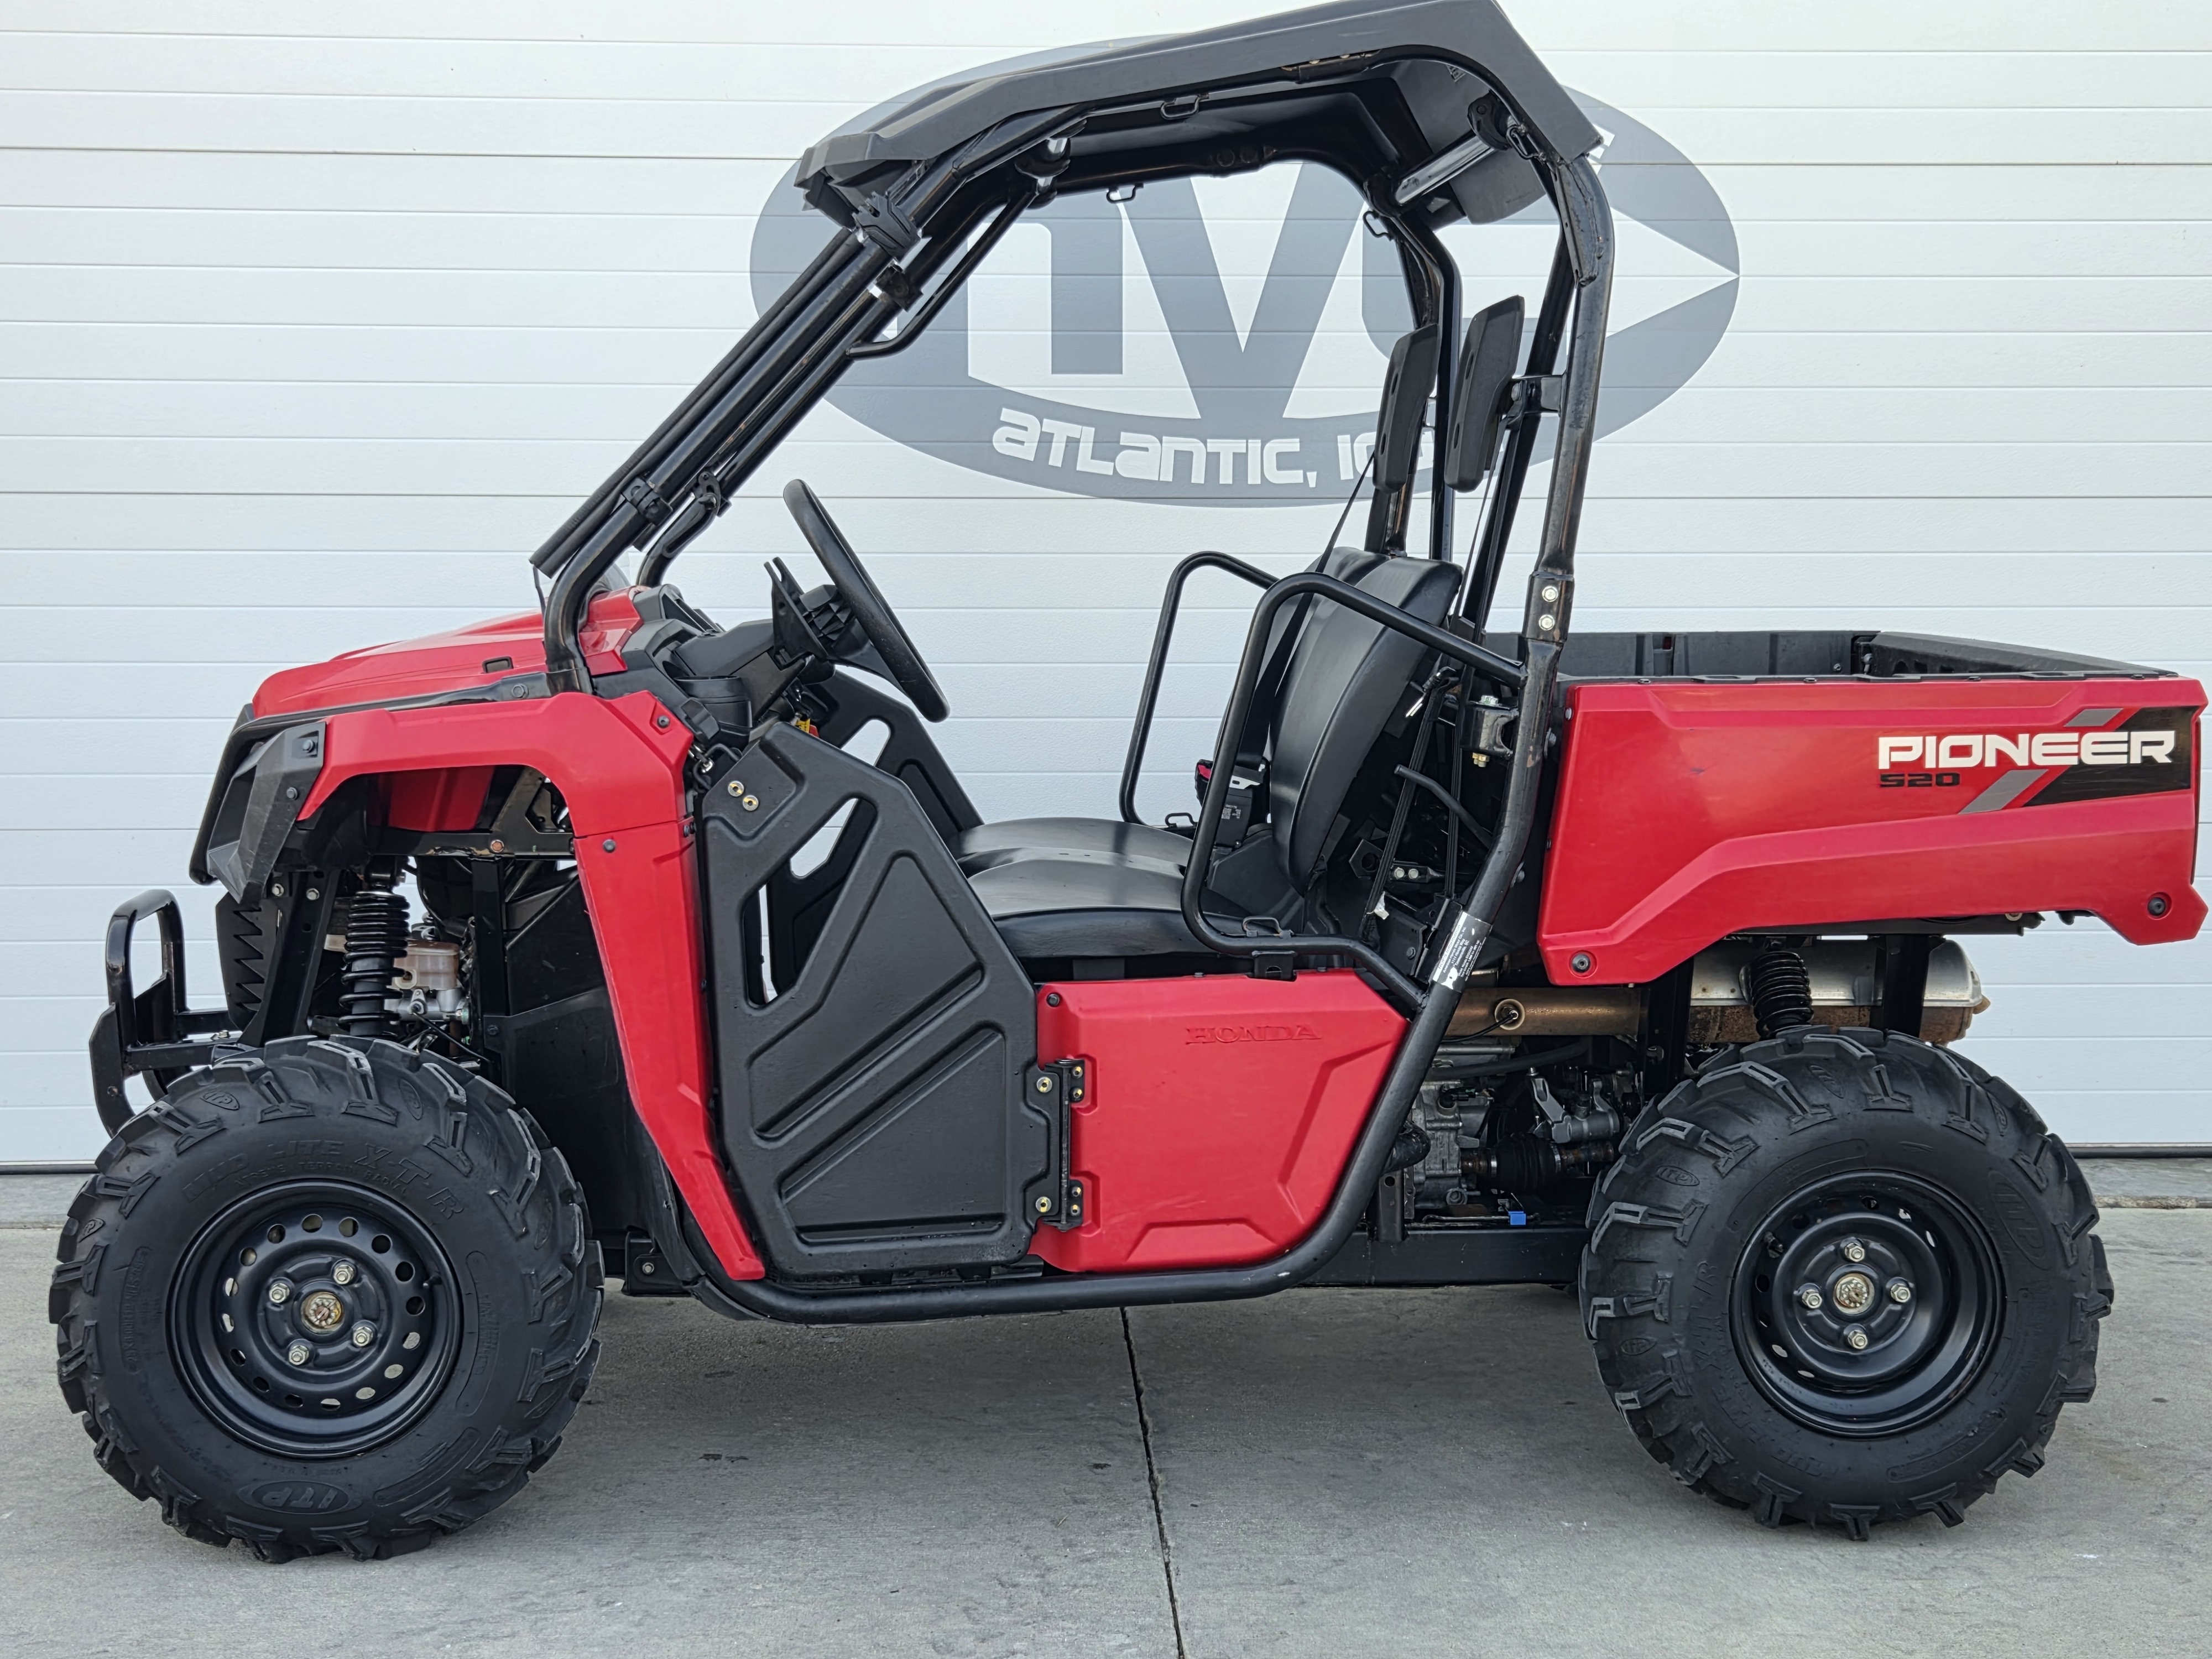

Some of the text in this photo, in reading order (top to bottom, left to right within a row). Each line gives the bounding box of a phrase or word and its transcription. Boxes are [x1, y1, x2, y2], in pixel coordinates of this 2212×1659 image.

[1879, 731, 2176, 769] PIONEER
[1880, 773, 1960, 787] 520
[1446, 924, 1460, 953] Information
[1186, 1024, 1321, 1045] HONDA
[262, 1487, 337, 1509] ITP
